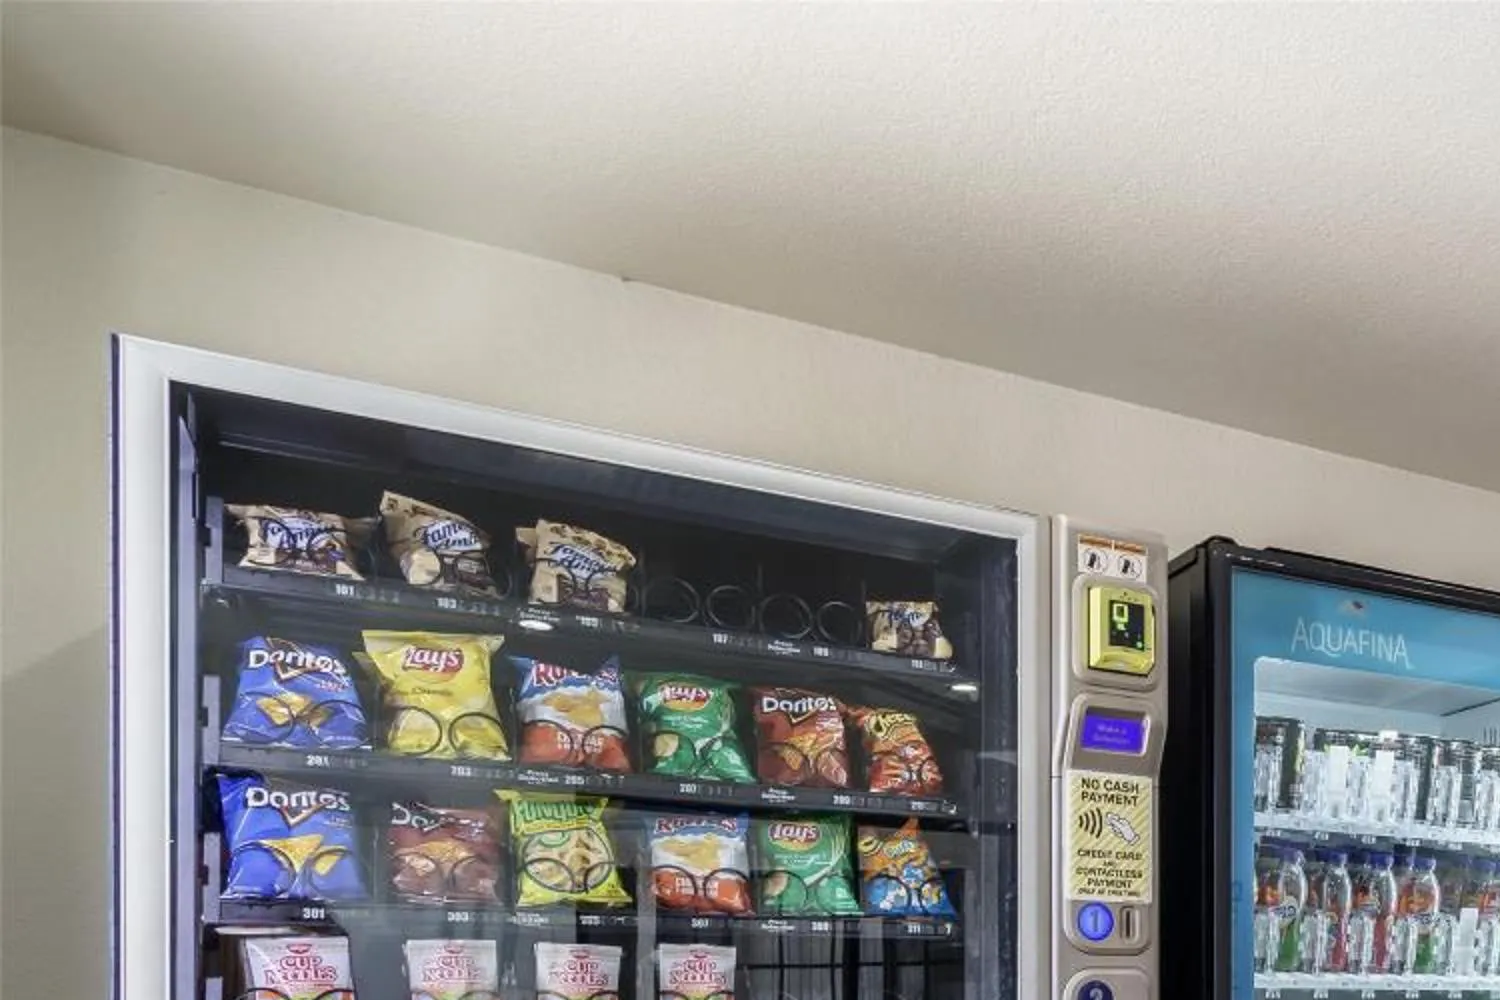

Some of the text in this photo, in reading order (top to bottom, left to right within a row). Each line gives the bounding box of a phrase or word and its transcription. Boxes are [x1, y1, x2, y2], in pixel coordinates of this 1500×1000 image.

[1291, 618, 1414, 670] AQUAFINA
[249, 650, 348, 680] Doritos
[762, 696, 837, 714] Doritos
[1081, 778, 1140, 794] NO CASH
[246, 787, 350, 811] Doritos
[1081, 791, 1140, 807] PAYMENT
[1077, 848, 1142, 861] CREDIT CARD
[1076, 867, 1143, 879] CONTACTLESS
[1087, 878, 1133, 889] PAYMENT
[303, 908, 325, 919] 301
[1089, 909, 1099, 933] 1
[280, 956, 322, 970] CUP
[265, 966, 337, 984] NOODLES
